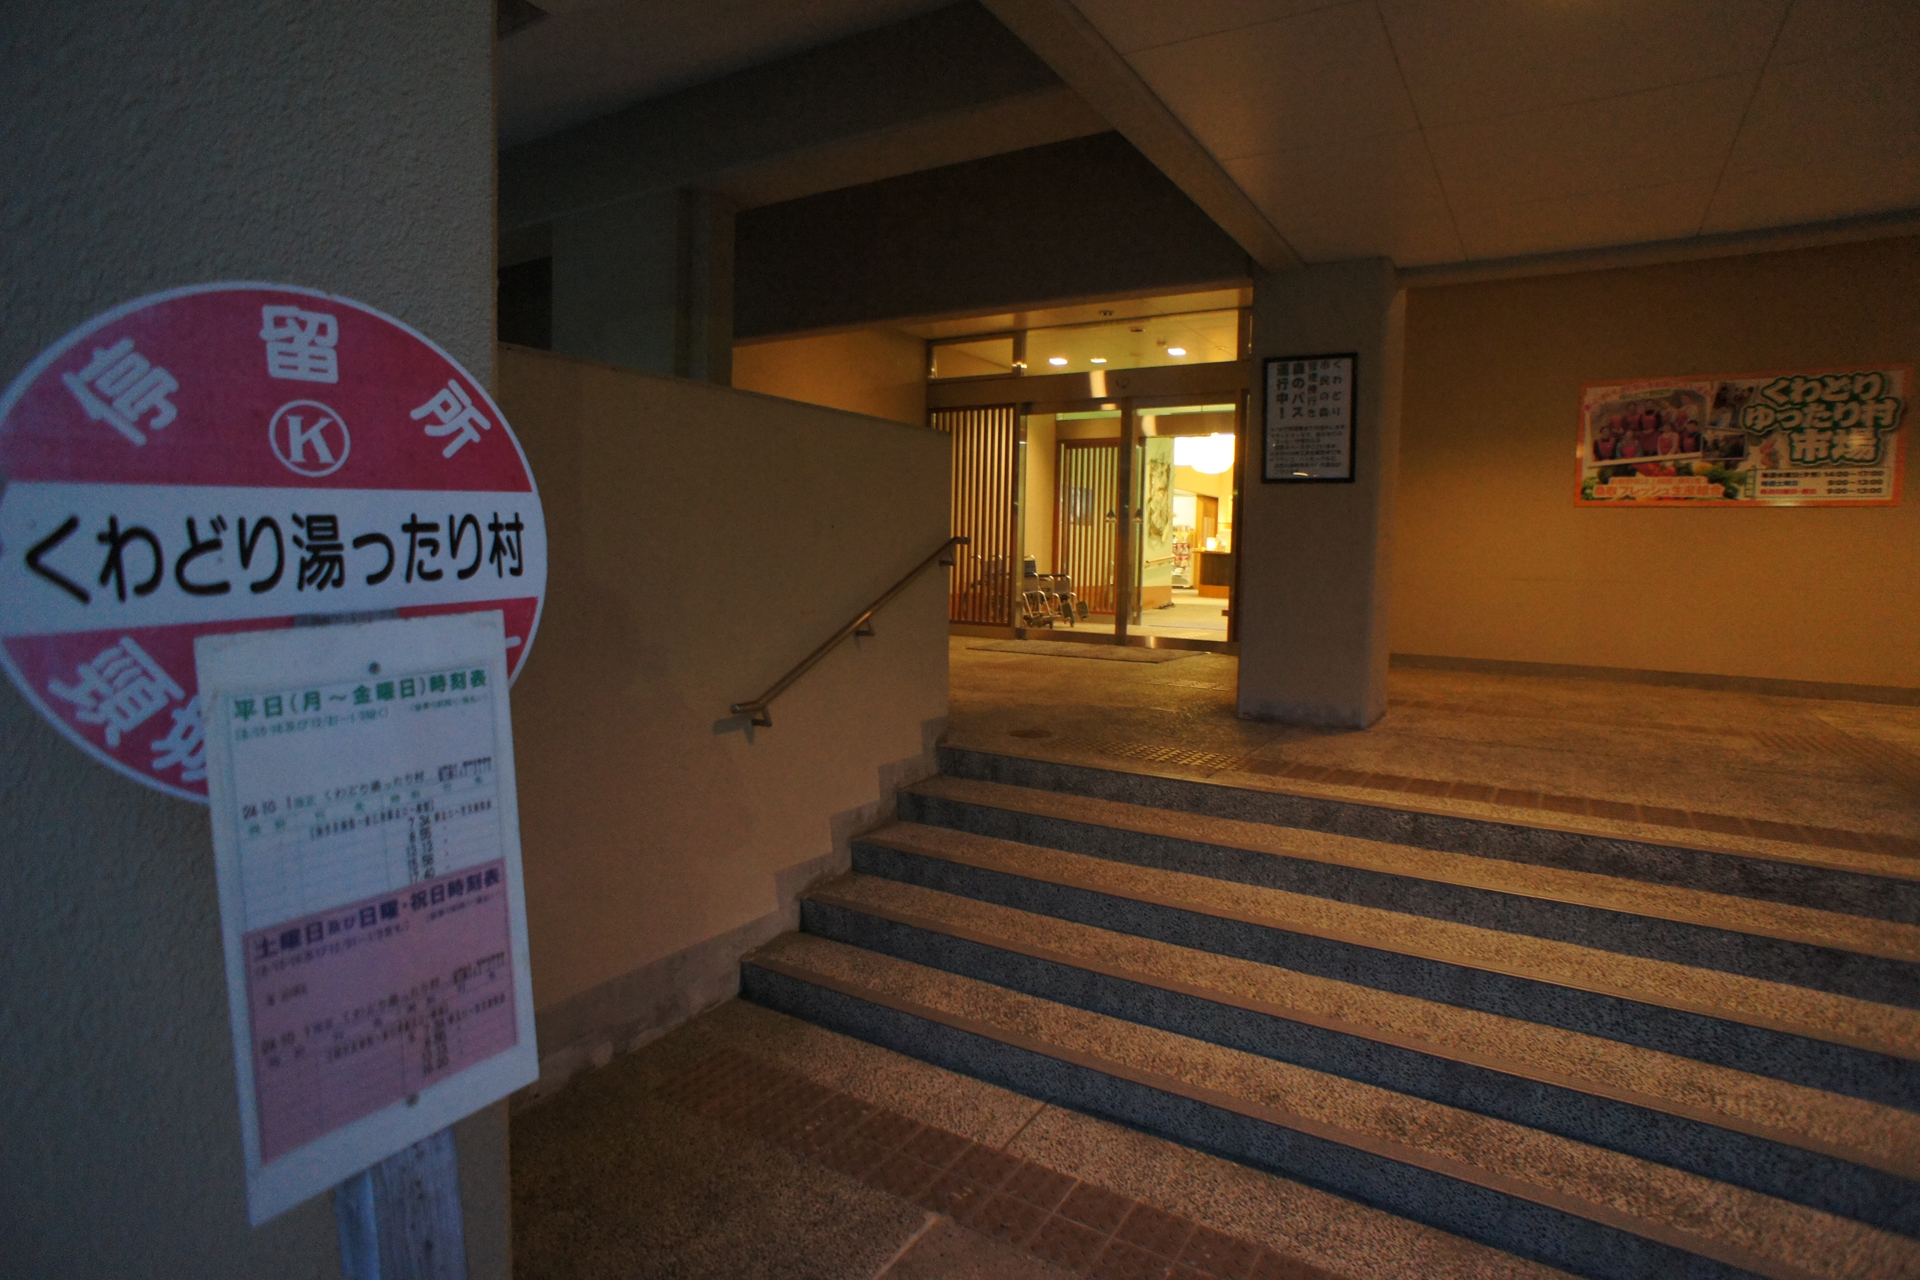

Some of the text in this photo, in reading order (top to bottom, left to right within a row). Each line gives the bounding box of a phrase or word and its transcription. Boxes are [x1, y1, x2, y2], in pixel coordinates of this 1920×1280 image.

[1743, 397, 1901, 432] ゆったり村
[1790, 428, 1879, 462] 市場
[26, 511, 525, 605] くわどり湯ったり村
